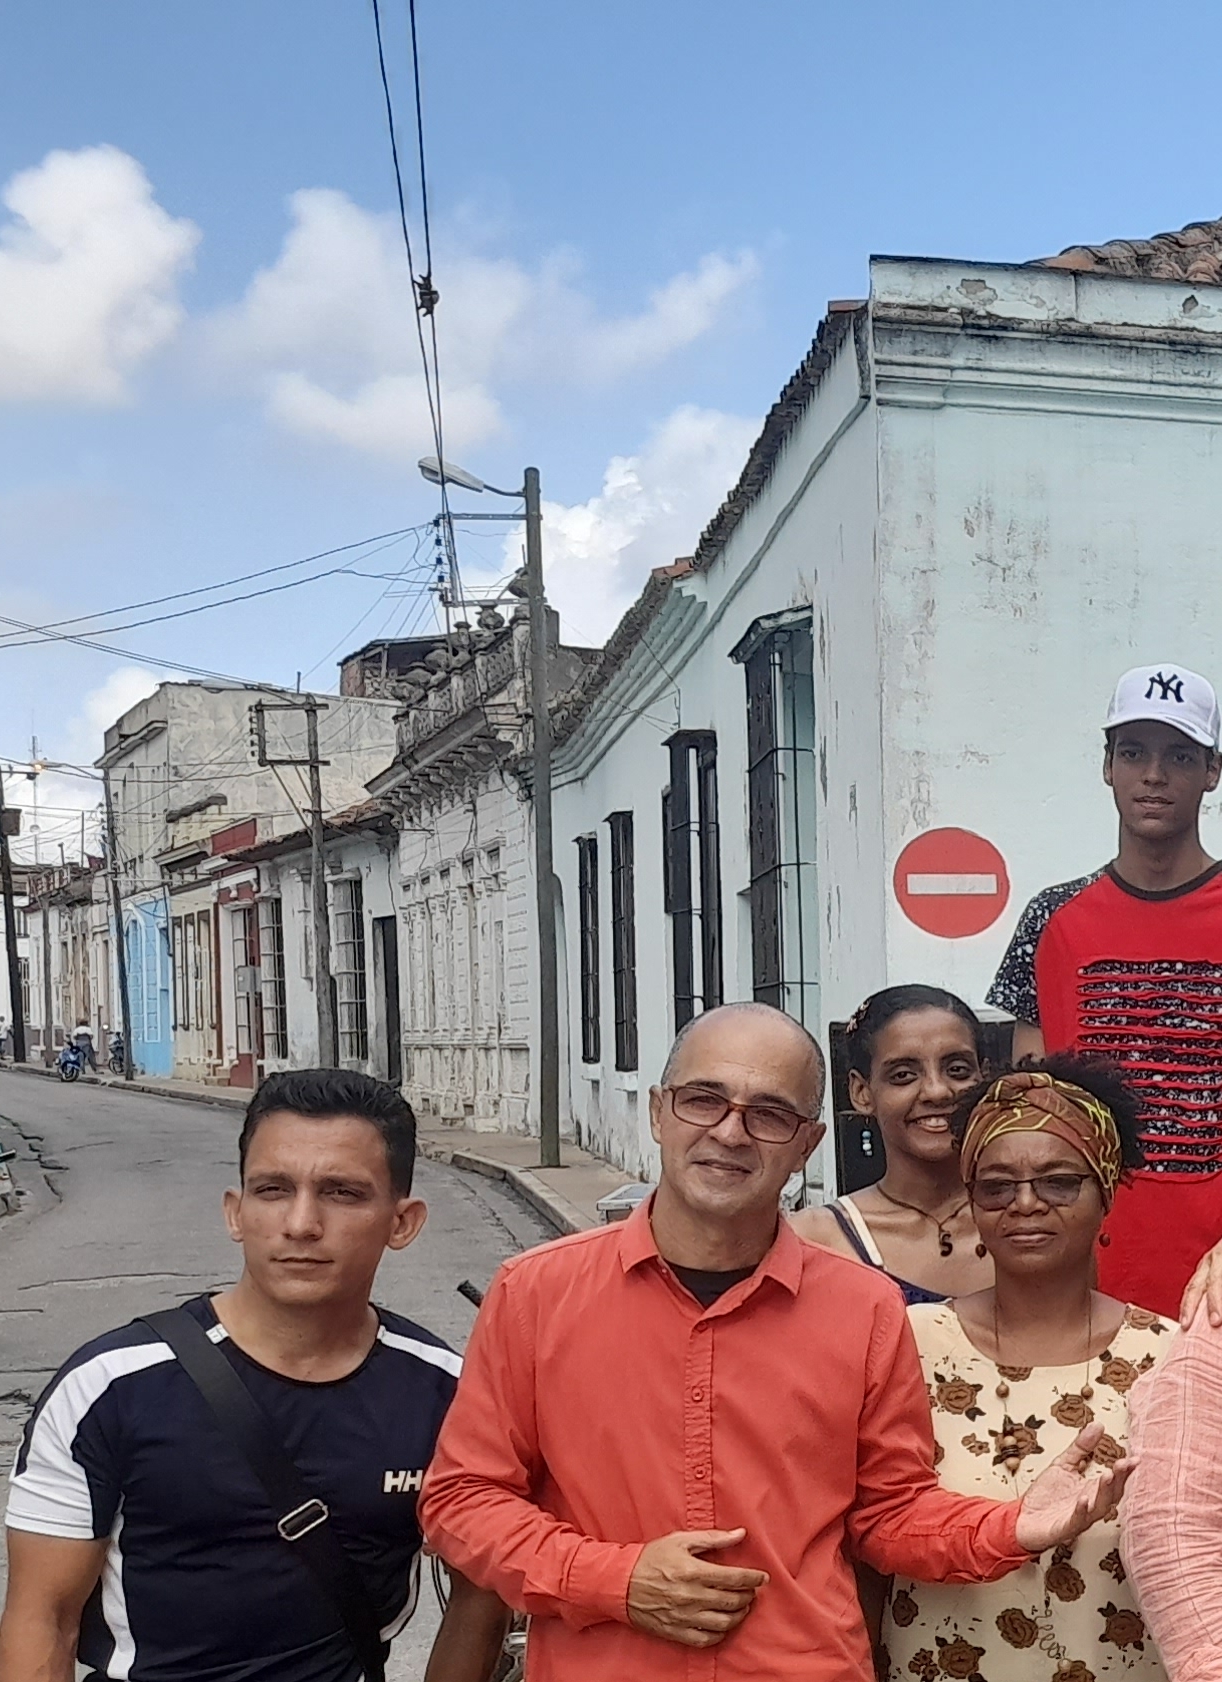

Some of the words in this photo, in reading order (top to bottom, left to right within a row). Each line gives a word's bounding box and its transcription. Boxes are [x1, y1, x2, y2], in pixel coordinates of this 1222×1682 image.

[1144, 671, 1185, 703] NY
[940, 1233, 953, 1257] S
[383, 1469, 424, 1493] HH
